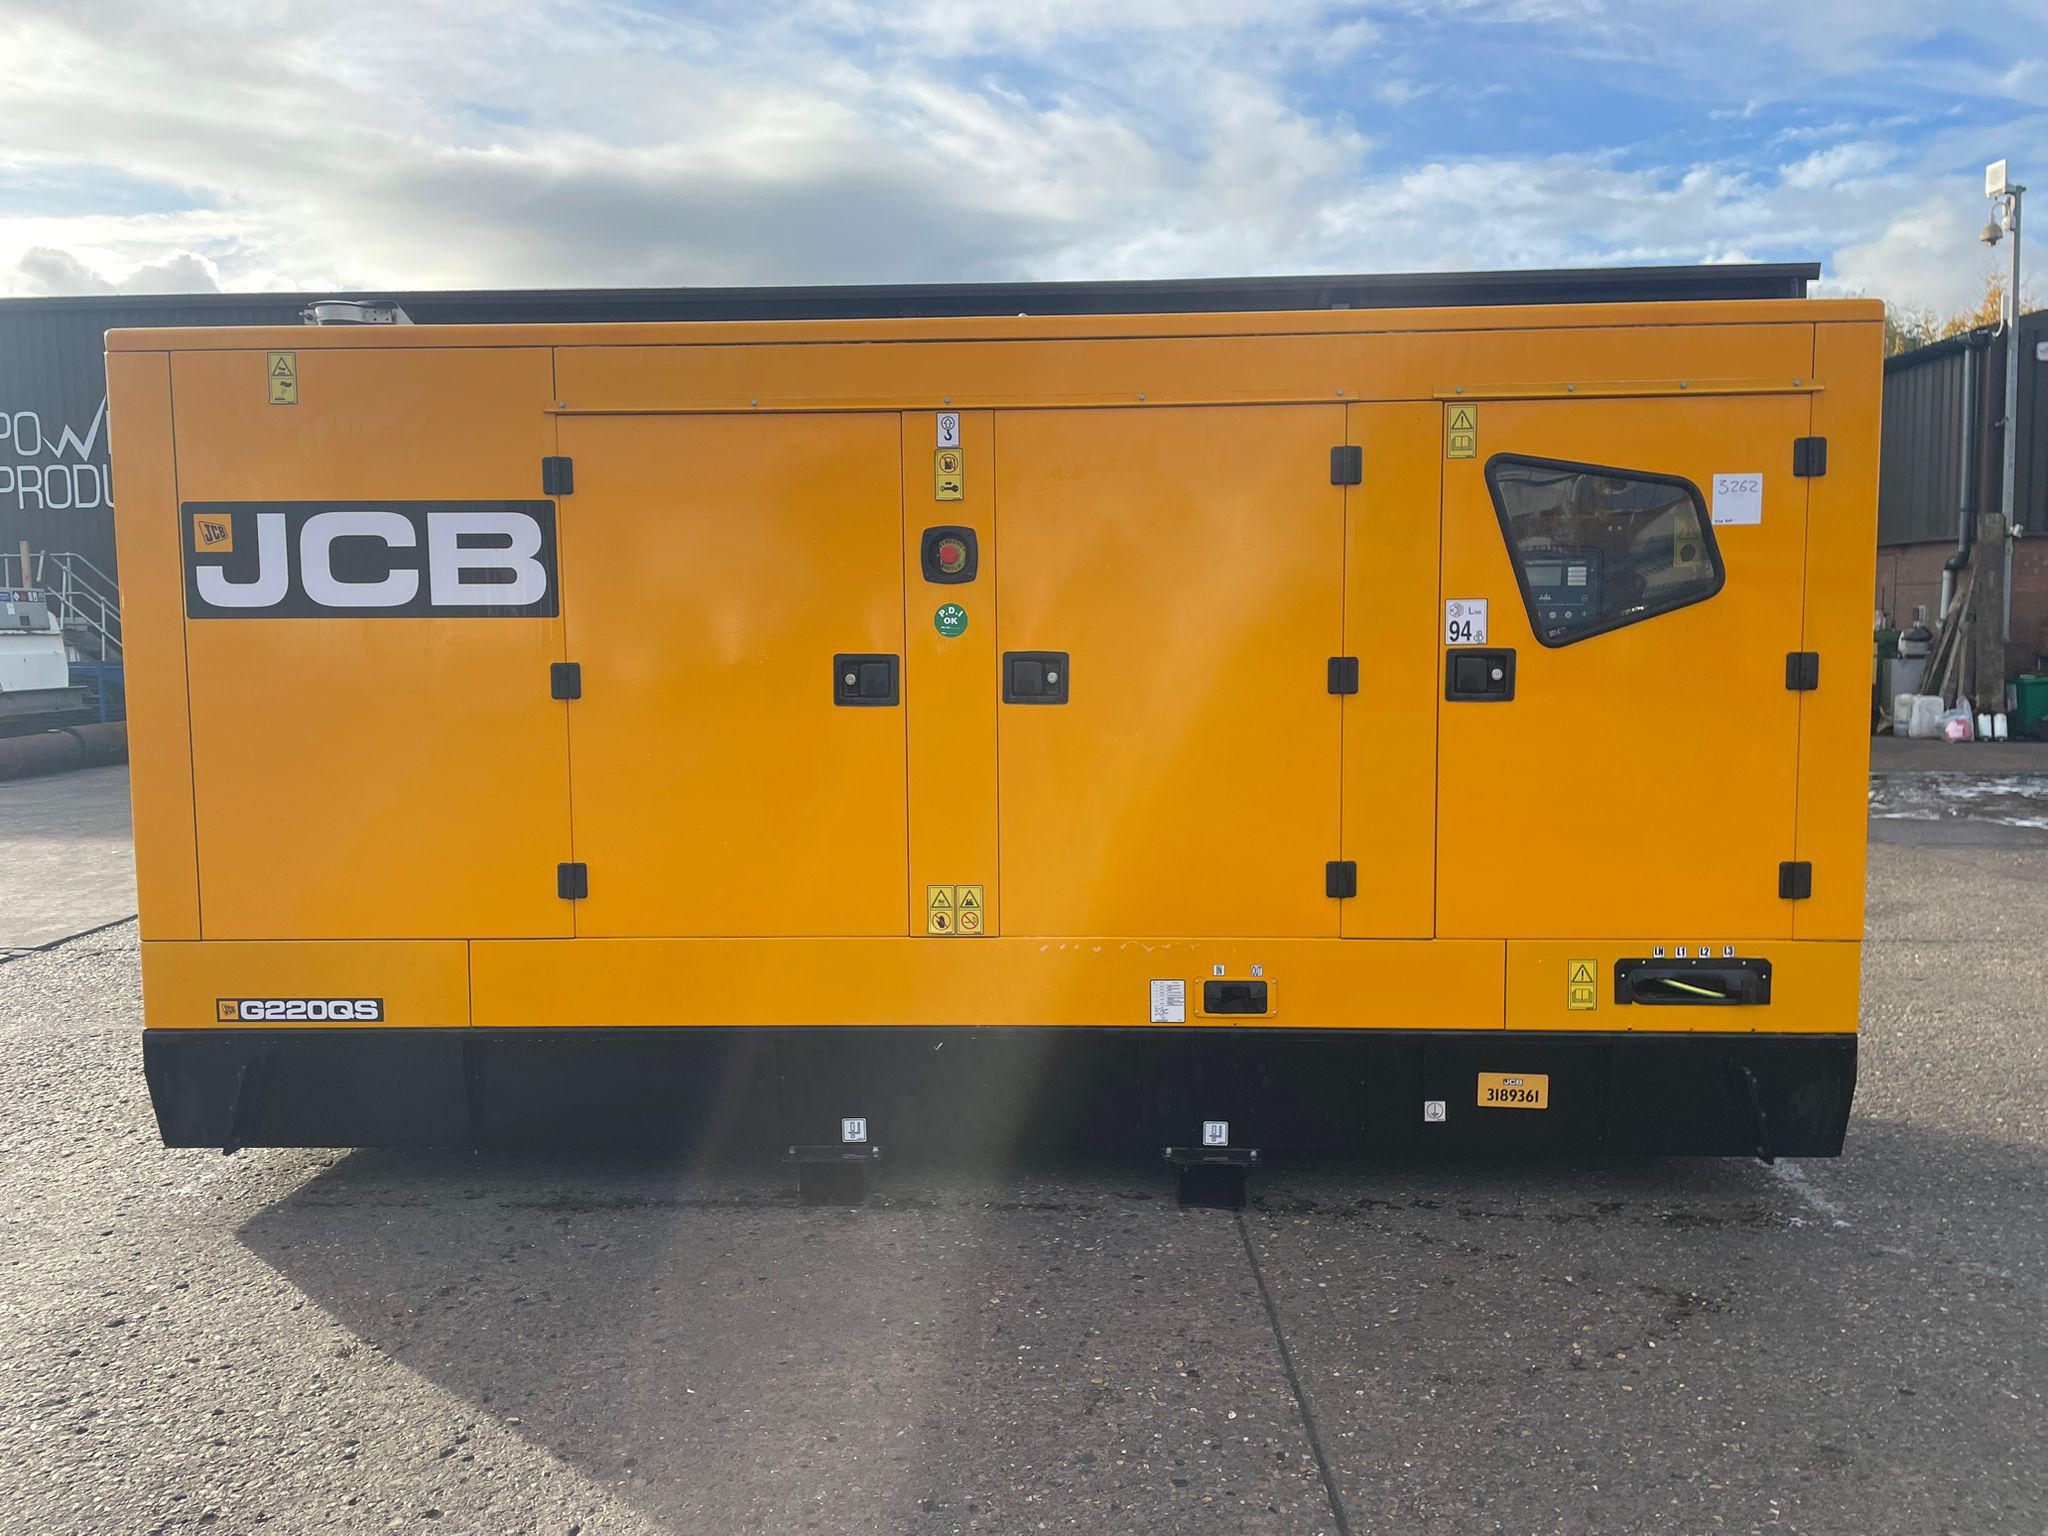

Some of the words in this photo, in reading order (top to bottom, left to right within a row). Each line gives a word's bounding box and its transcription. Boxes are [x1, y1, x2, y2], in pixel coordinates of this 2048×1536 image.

[203, 523, 227, 542] JCB
[196, 511, 547, 607] JCB
[943, 616, 958, 625] OK
[1449, 620, 1472, 642] 94
[240, 1000, 379, 1020] G220QS
[1486, 1088, 1539, 1104] 3189361
